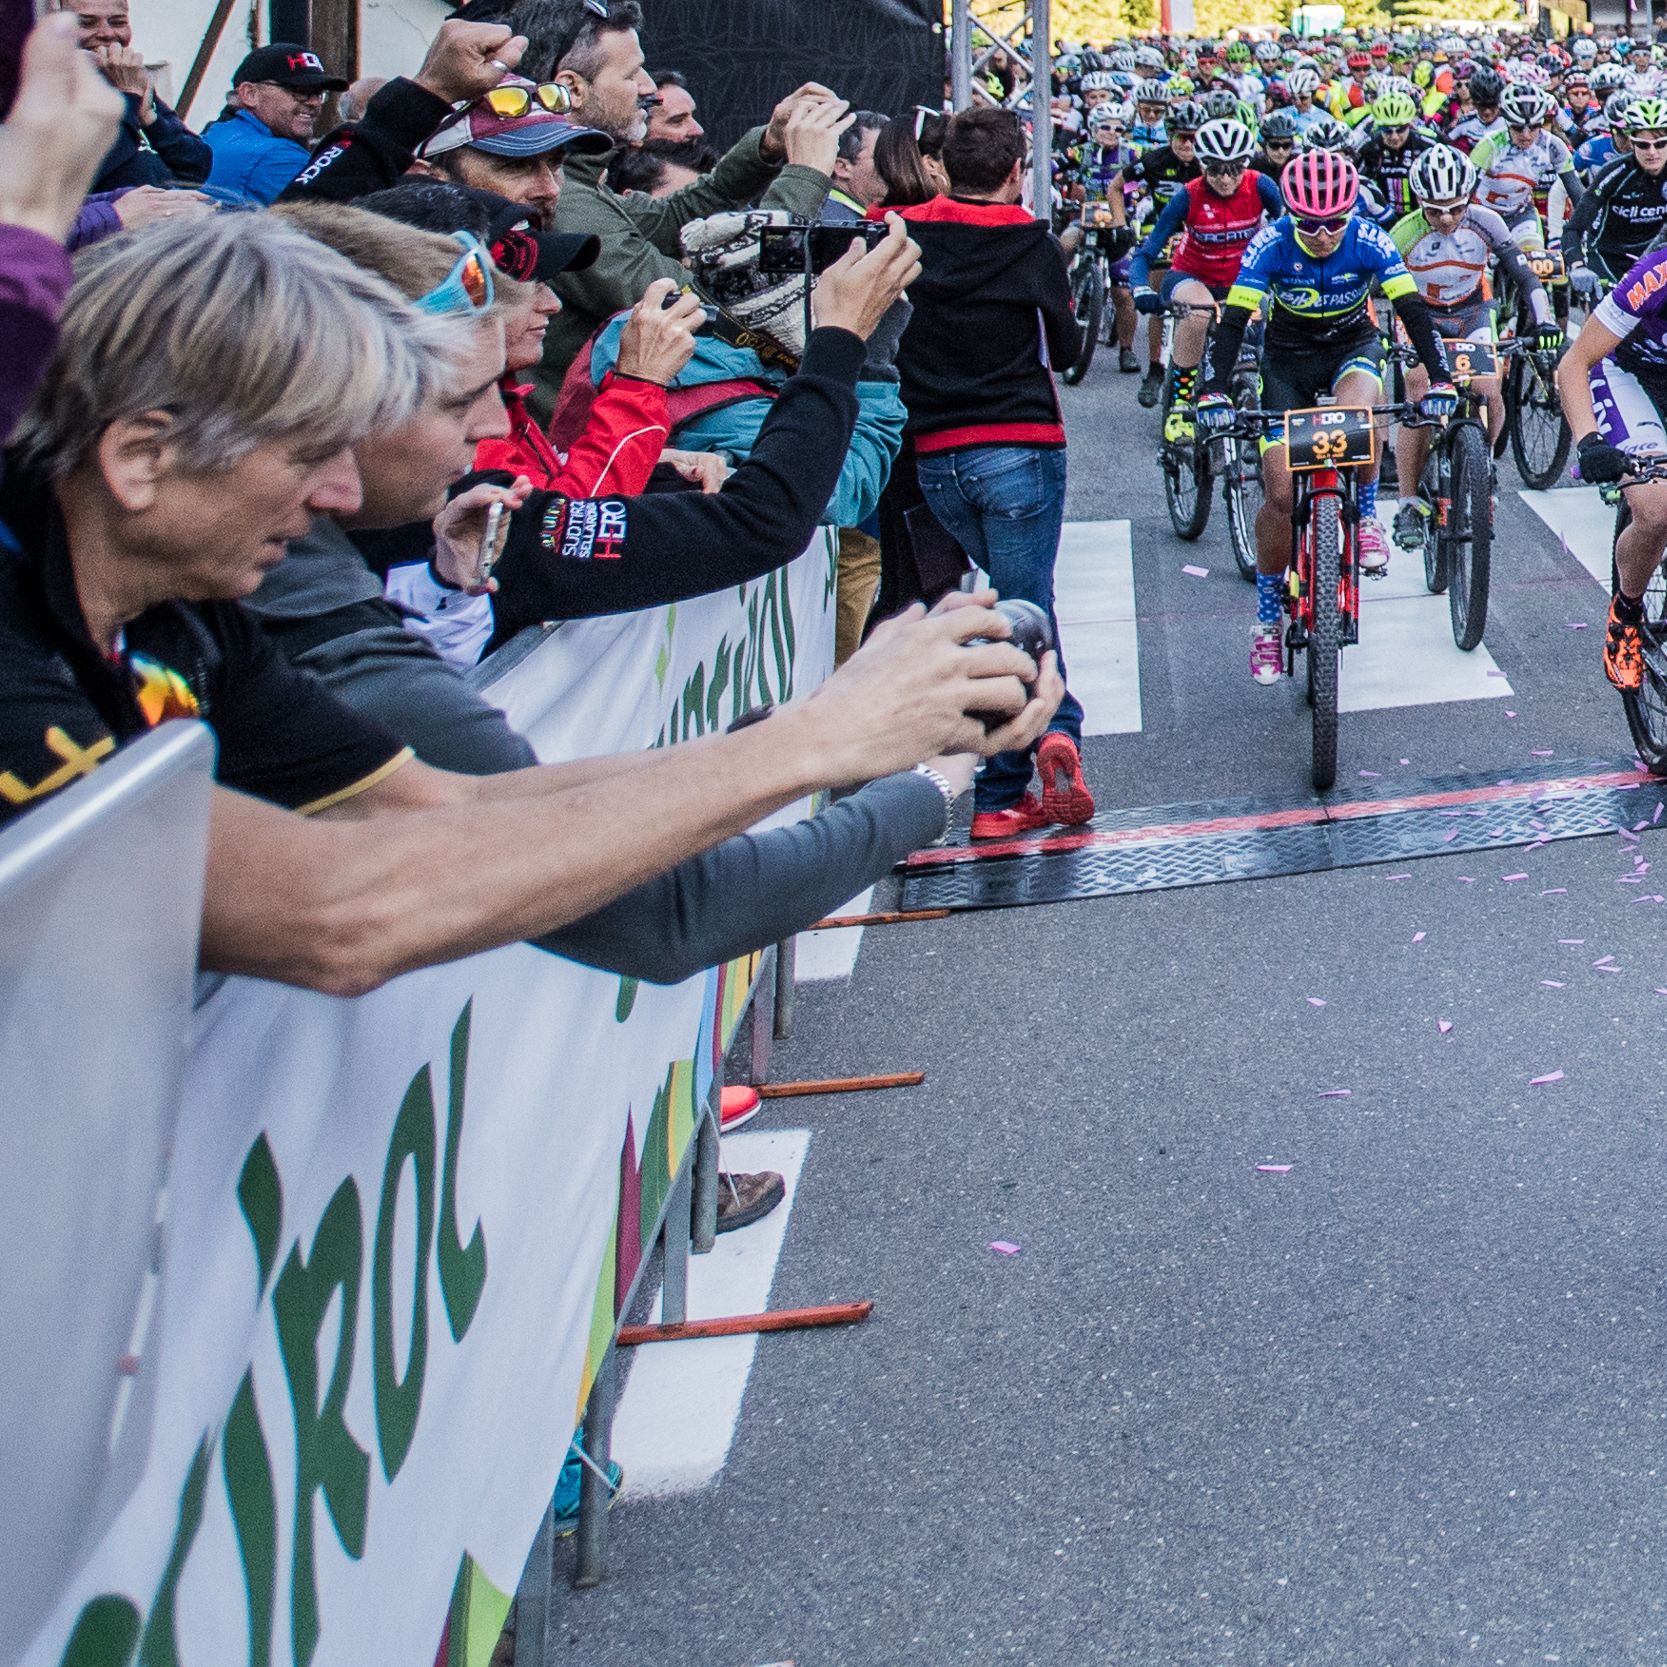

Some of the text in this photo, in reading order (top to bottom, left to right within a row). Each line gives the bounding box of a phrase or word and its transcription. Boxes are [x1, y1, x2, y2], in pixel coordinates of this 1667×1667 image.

[1454, 353, 1472, 373] 6
[1312, 411, 1346, 427] HERO
[1312, 429, 1348, 455] 33
[594, 500, 629, 560] HERO
